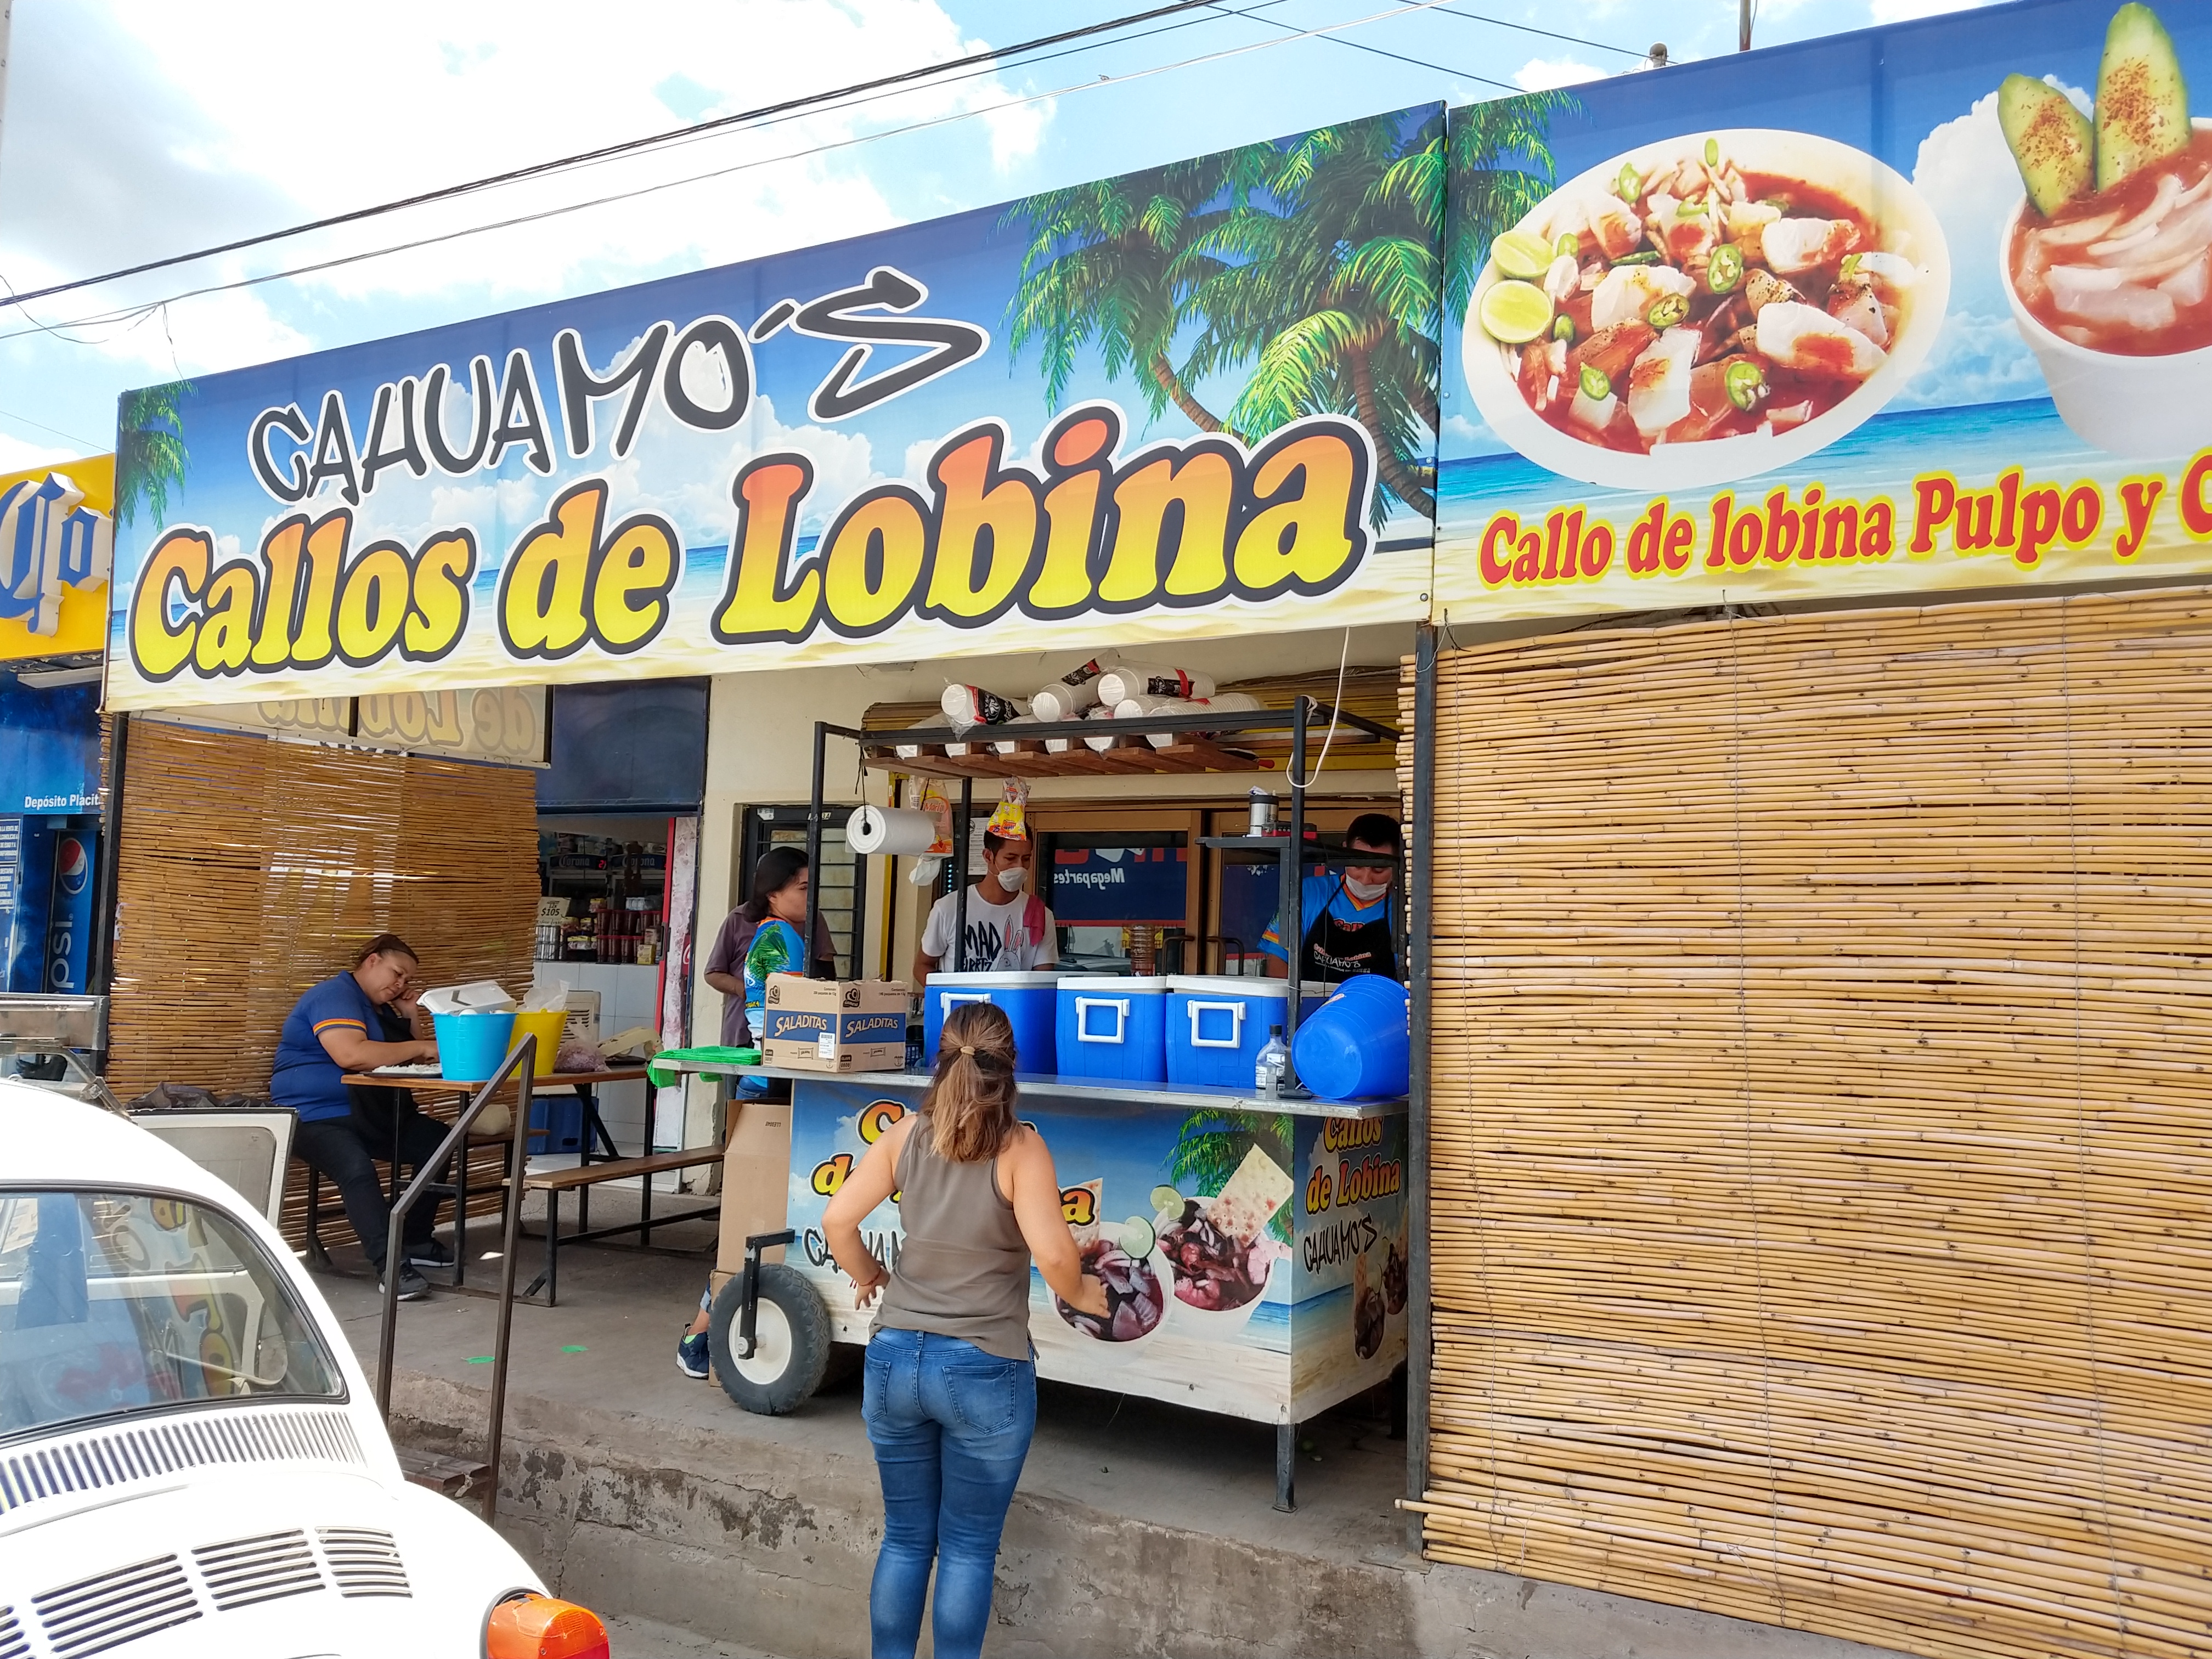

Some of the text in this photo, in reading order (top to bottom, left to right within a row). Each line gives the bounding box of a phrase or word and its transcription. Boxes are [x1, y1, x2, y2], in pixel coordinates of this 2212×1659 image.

[250, 268, 988, 507] CAHUAMO'S
[129, 403, 1377, 684] Callos de Lobina
[1479, 502, 1614, 589] Callo
[1626, 495, 1697, 579] de
[1704, 481, 1895, 574] lobina
[1907, 465, 2104, 572] Pulpo
[2113, 473, 2167, 564] y
[25, 794, 101, 810] Depósito Placit
[559, 856, 590, 868] Corona
[540, 907, 561, 916] $105
[50, 921, 75, 992] psi
[964, 920, 1002, 962] MAD
[774, 1014, 827, 1038] SALADITAS
[845, 1017, 899, 1039] SALADITAS
[1323, 1116, 1384, 1153] Callos
[809, 1152, 857, 1197] d
[1306, 1153, 1401, 1216] de Lobina
[1302, 1212, 1378, 1275] CAHUAMO'S
